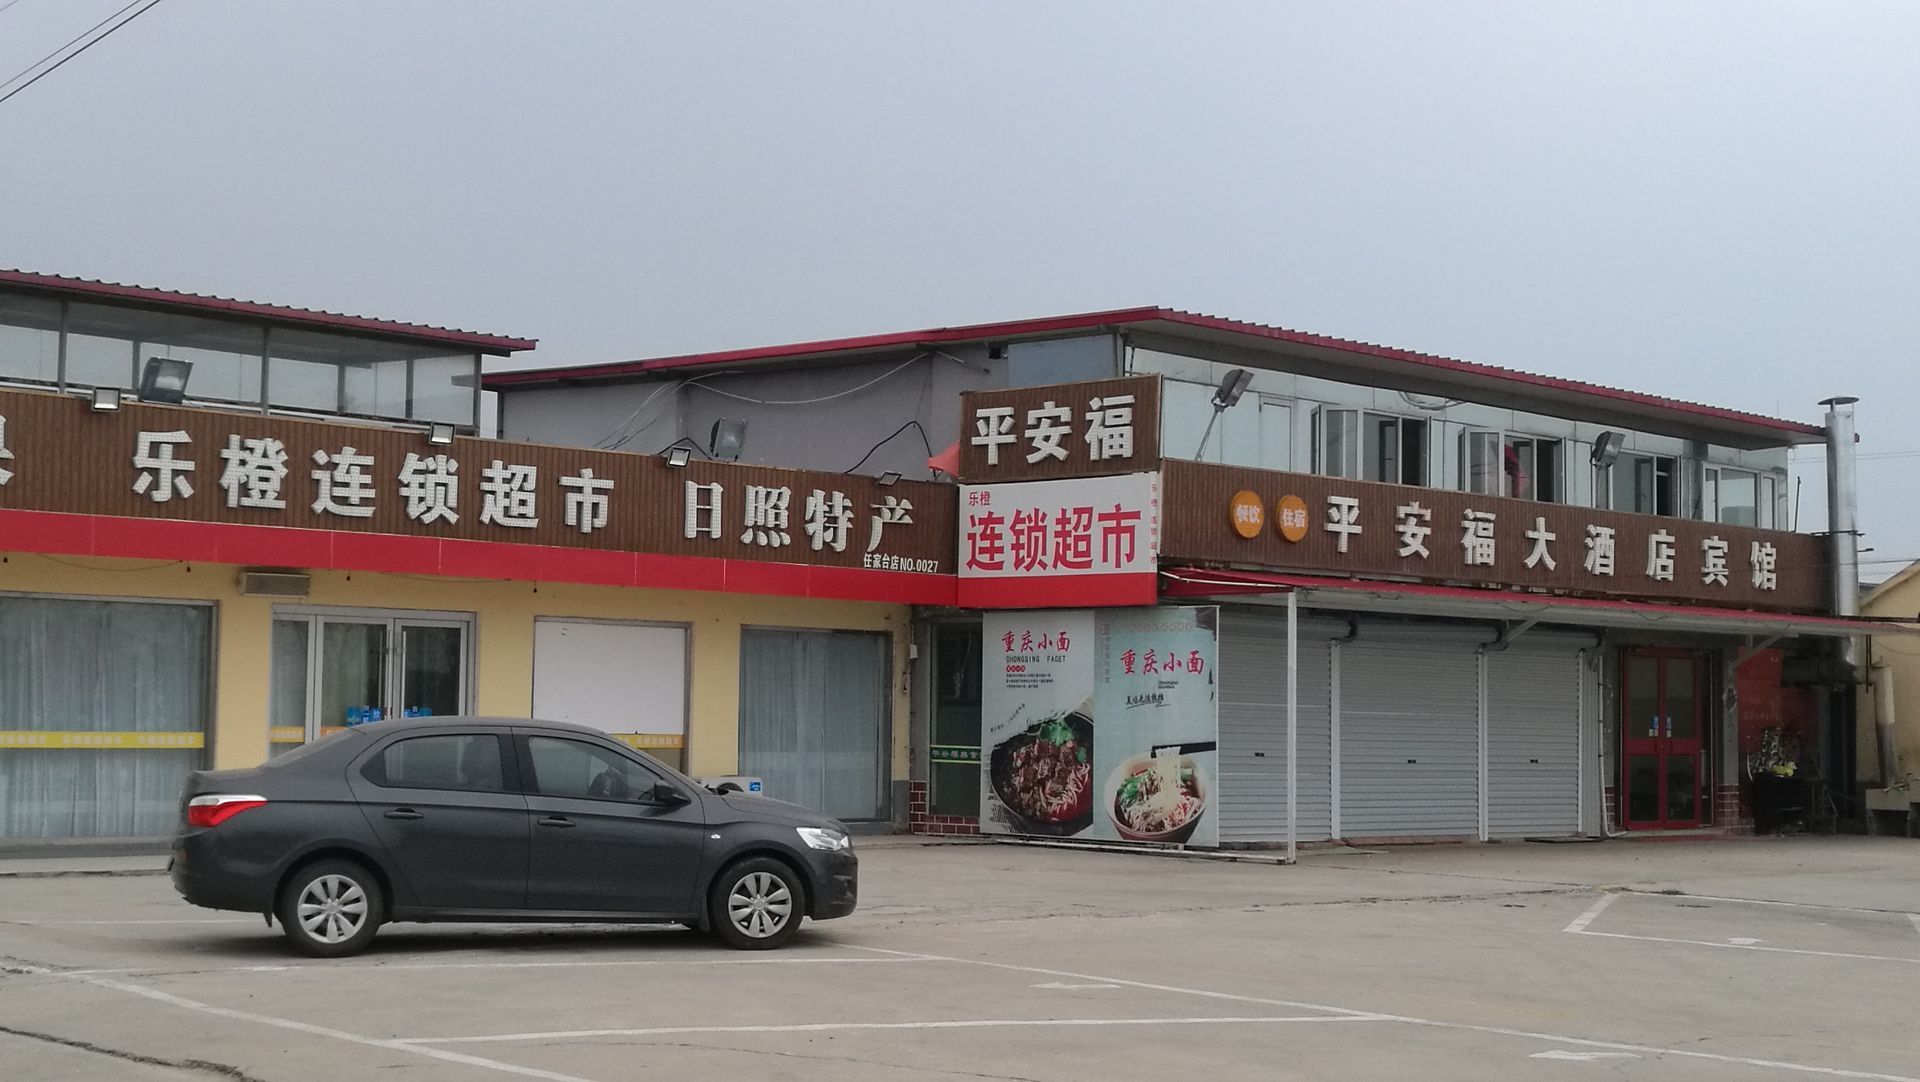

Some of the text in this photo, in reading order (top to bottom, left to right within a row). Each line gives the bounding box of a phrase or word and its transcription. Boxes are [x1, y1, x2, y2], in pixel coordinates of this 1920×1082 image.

[971, 395, 1136, 466] 平安福
[131, 429, 914, 552] 乐橙连锁超市 日照特产
[968, 491, 991, 507] 乐橙
[966, 503, 1142, 572] 连锁超市
[1323, 495, 1777, 590] 平安福大酒店宾馆
[1001, 630, 1071, 653] 重庆小面
[1120, 648, 1205, 675] 重庆小面
